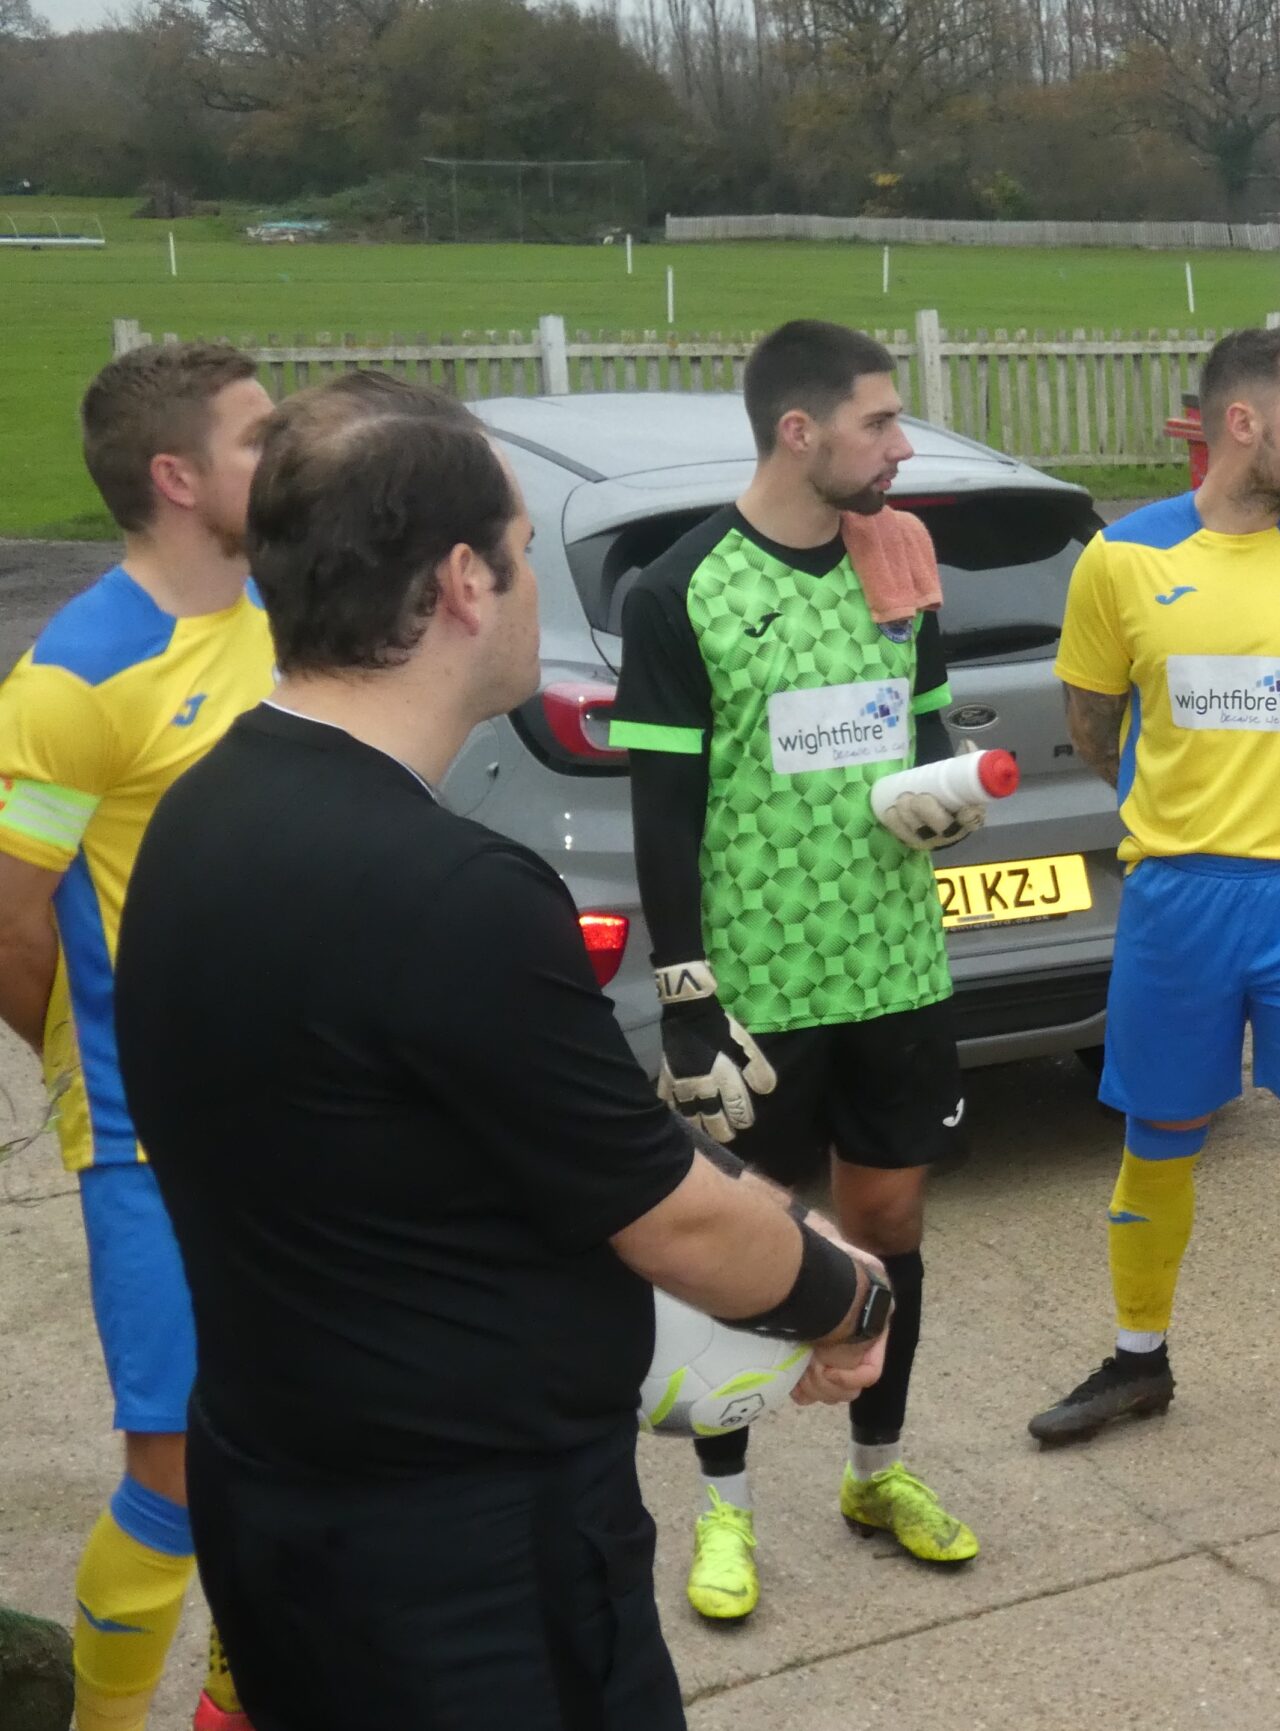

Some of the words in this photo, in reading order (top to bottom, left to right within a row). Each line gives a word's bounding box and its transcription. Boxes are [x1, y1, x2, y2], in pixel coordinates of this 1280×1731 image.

[1175, 688, 1277, 715] wightfibre
[778, 720, 883, 755] wightfibre
[980, 865, 1061, 912] KZJ
